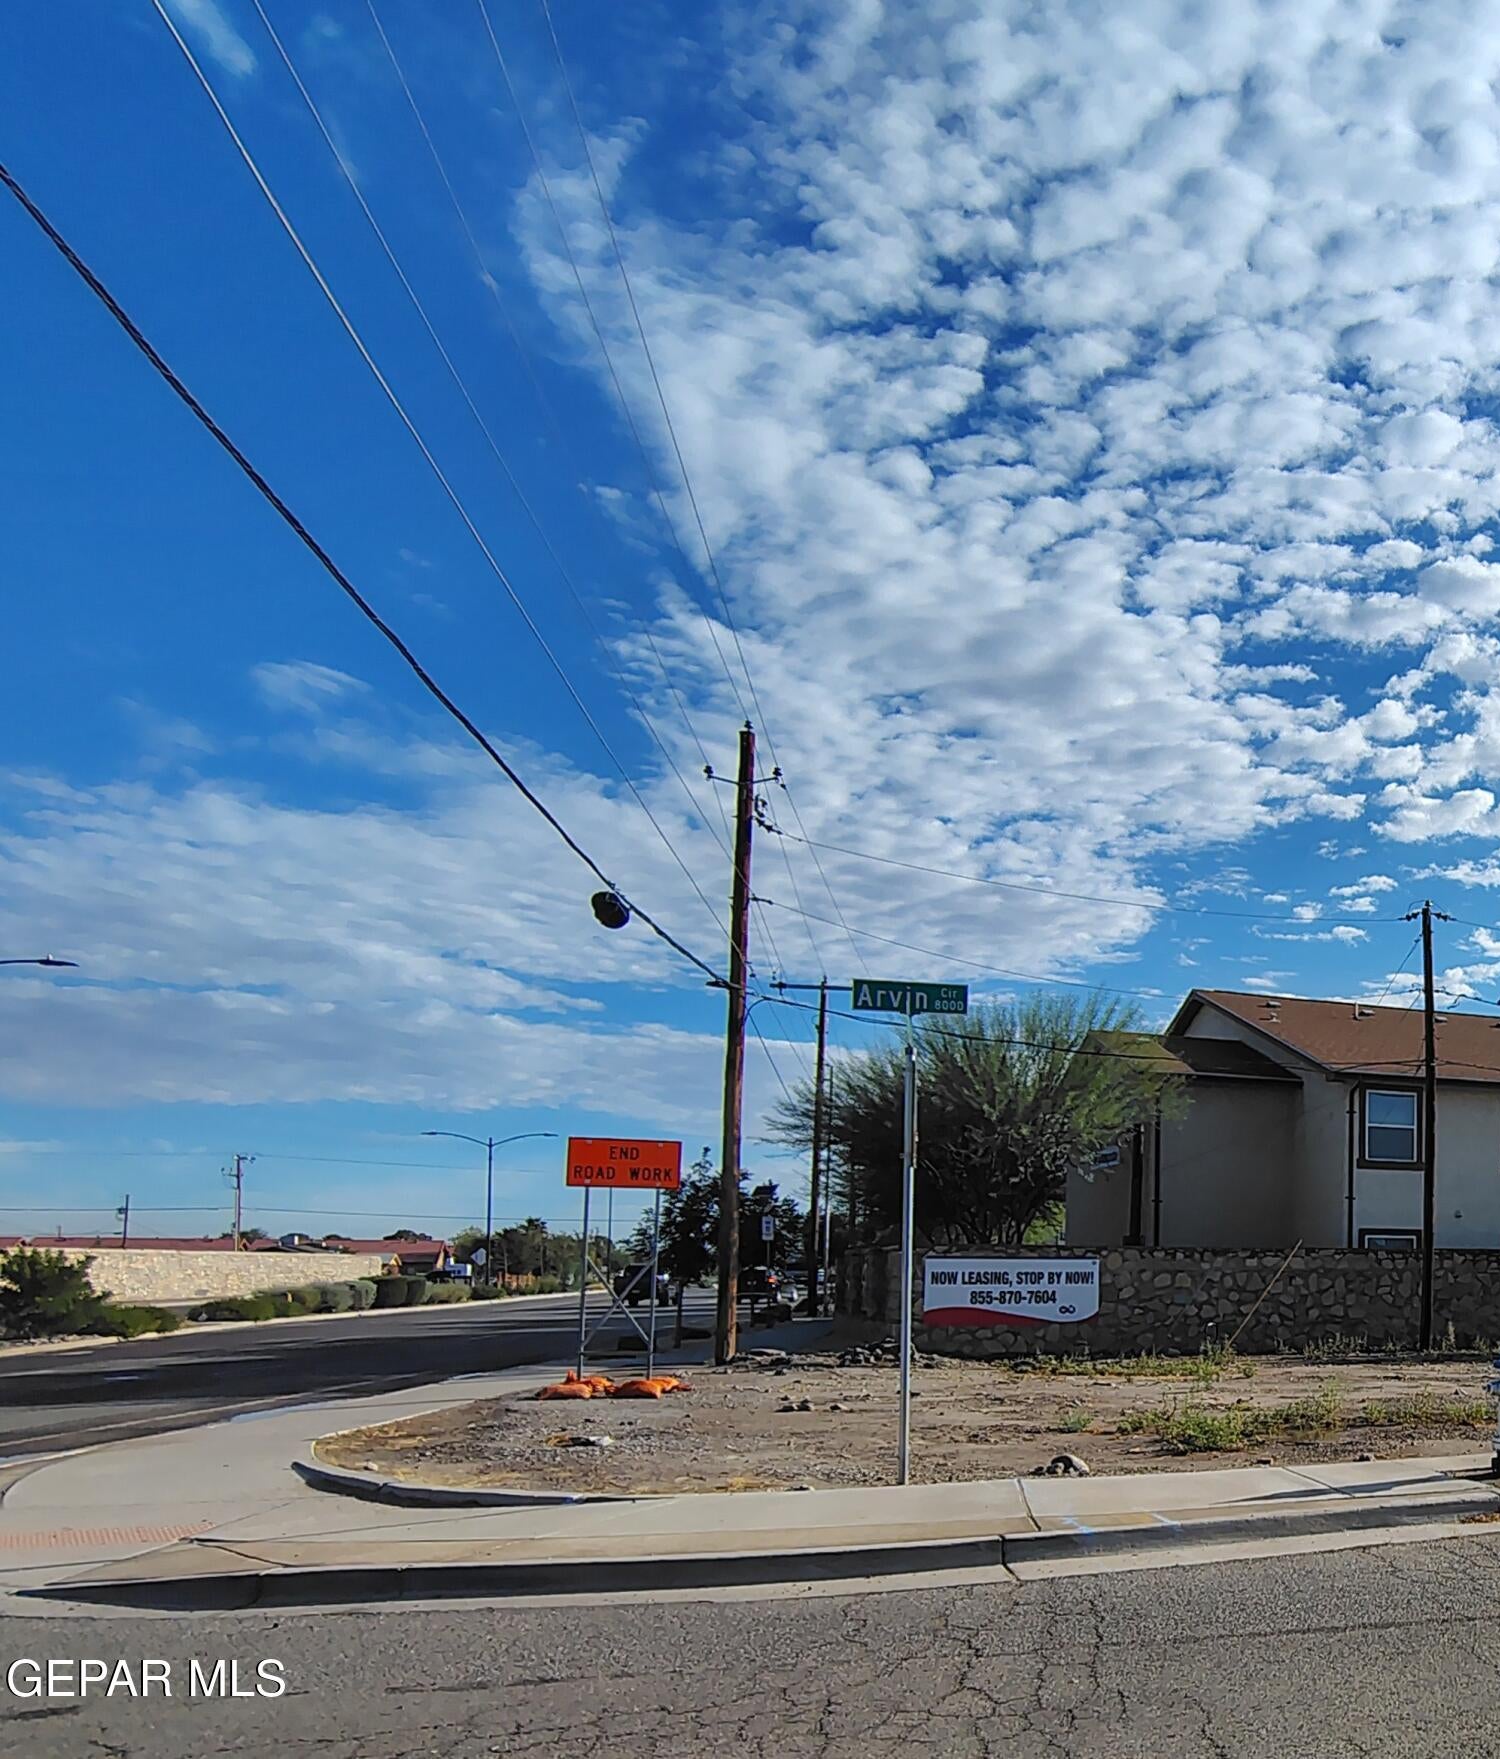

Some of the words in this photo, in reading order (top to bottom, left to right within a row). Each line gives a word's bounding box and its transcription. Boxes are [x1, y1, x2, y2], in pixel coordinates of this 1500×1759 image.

[857, 984, 928, 1010] Arvin
[940, 987, 957, 998] Cir
[934, 999, 964, 1011] 8000
[609, 1145, 640, 1160] END
[573, 1165, 616, 1180] ROAD
[629, 1167, 673, 1182] WORK
[931, 1271, 958, 1285] NOW
[961, 1271, 1013, 1287] LEASING,
[1016, 1271, 1045, 1285] STOP
[1047, 1271, 1062, 1285] BY
[1065, 1271, 1094, 1285] NOW!
[969, 1290, 1057, 1305] 855-870-7604
